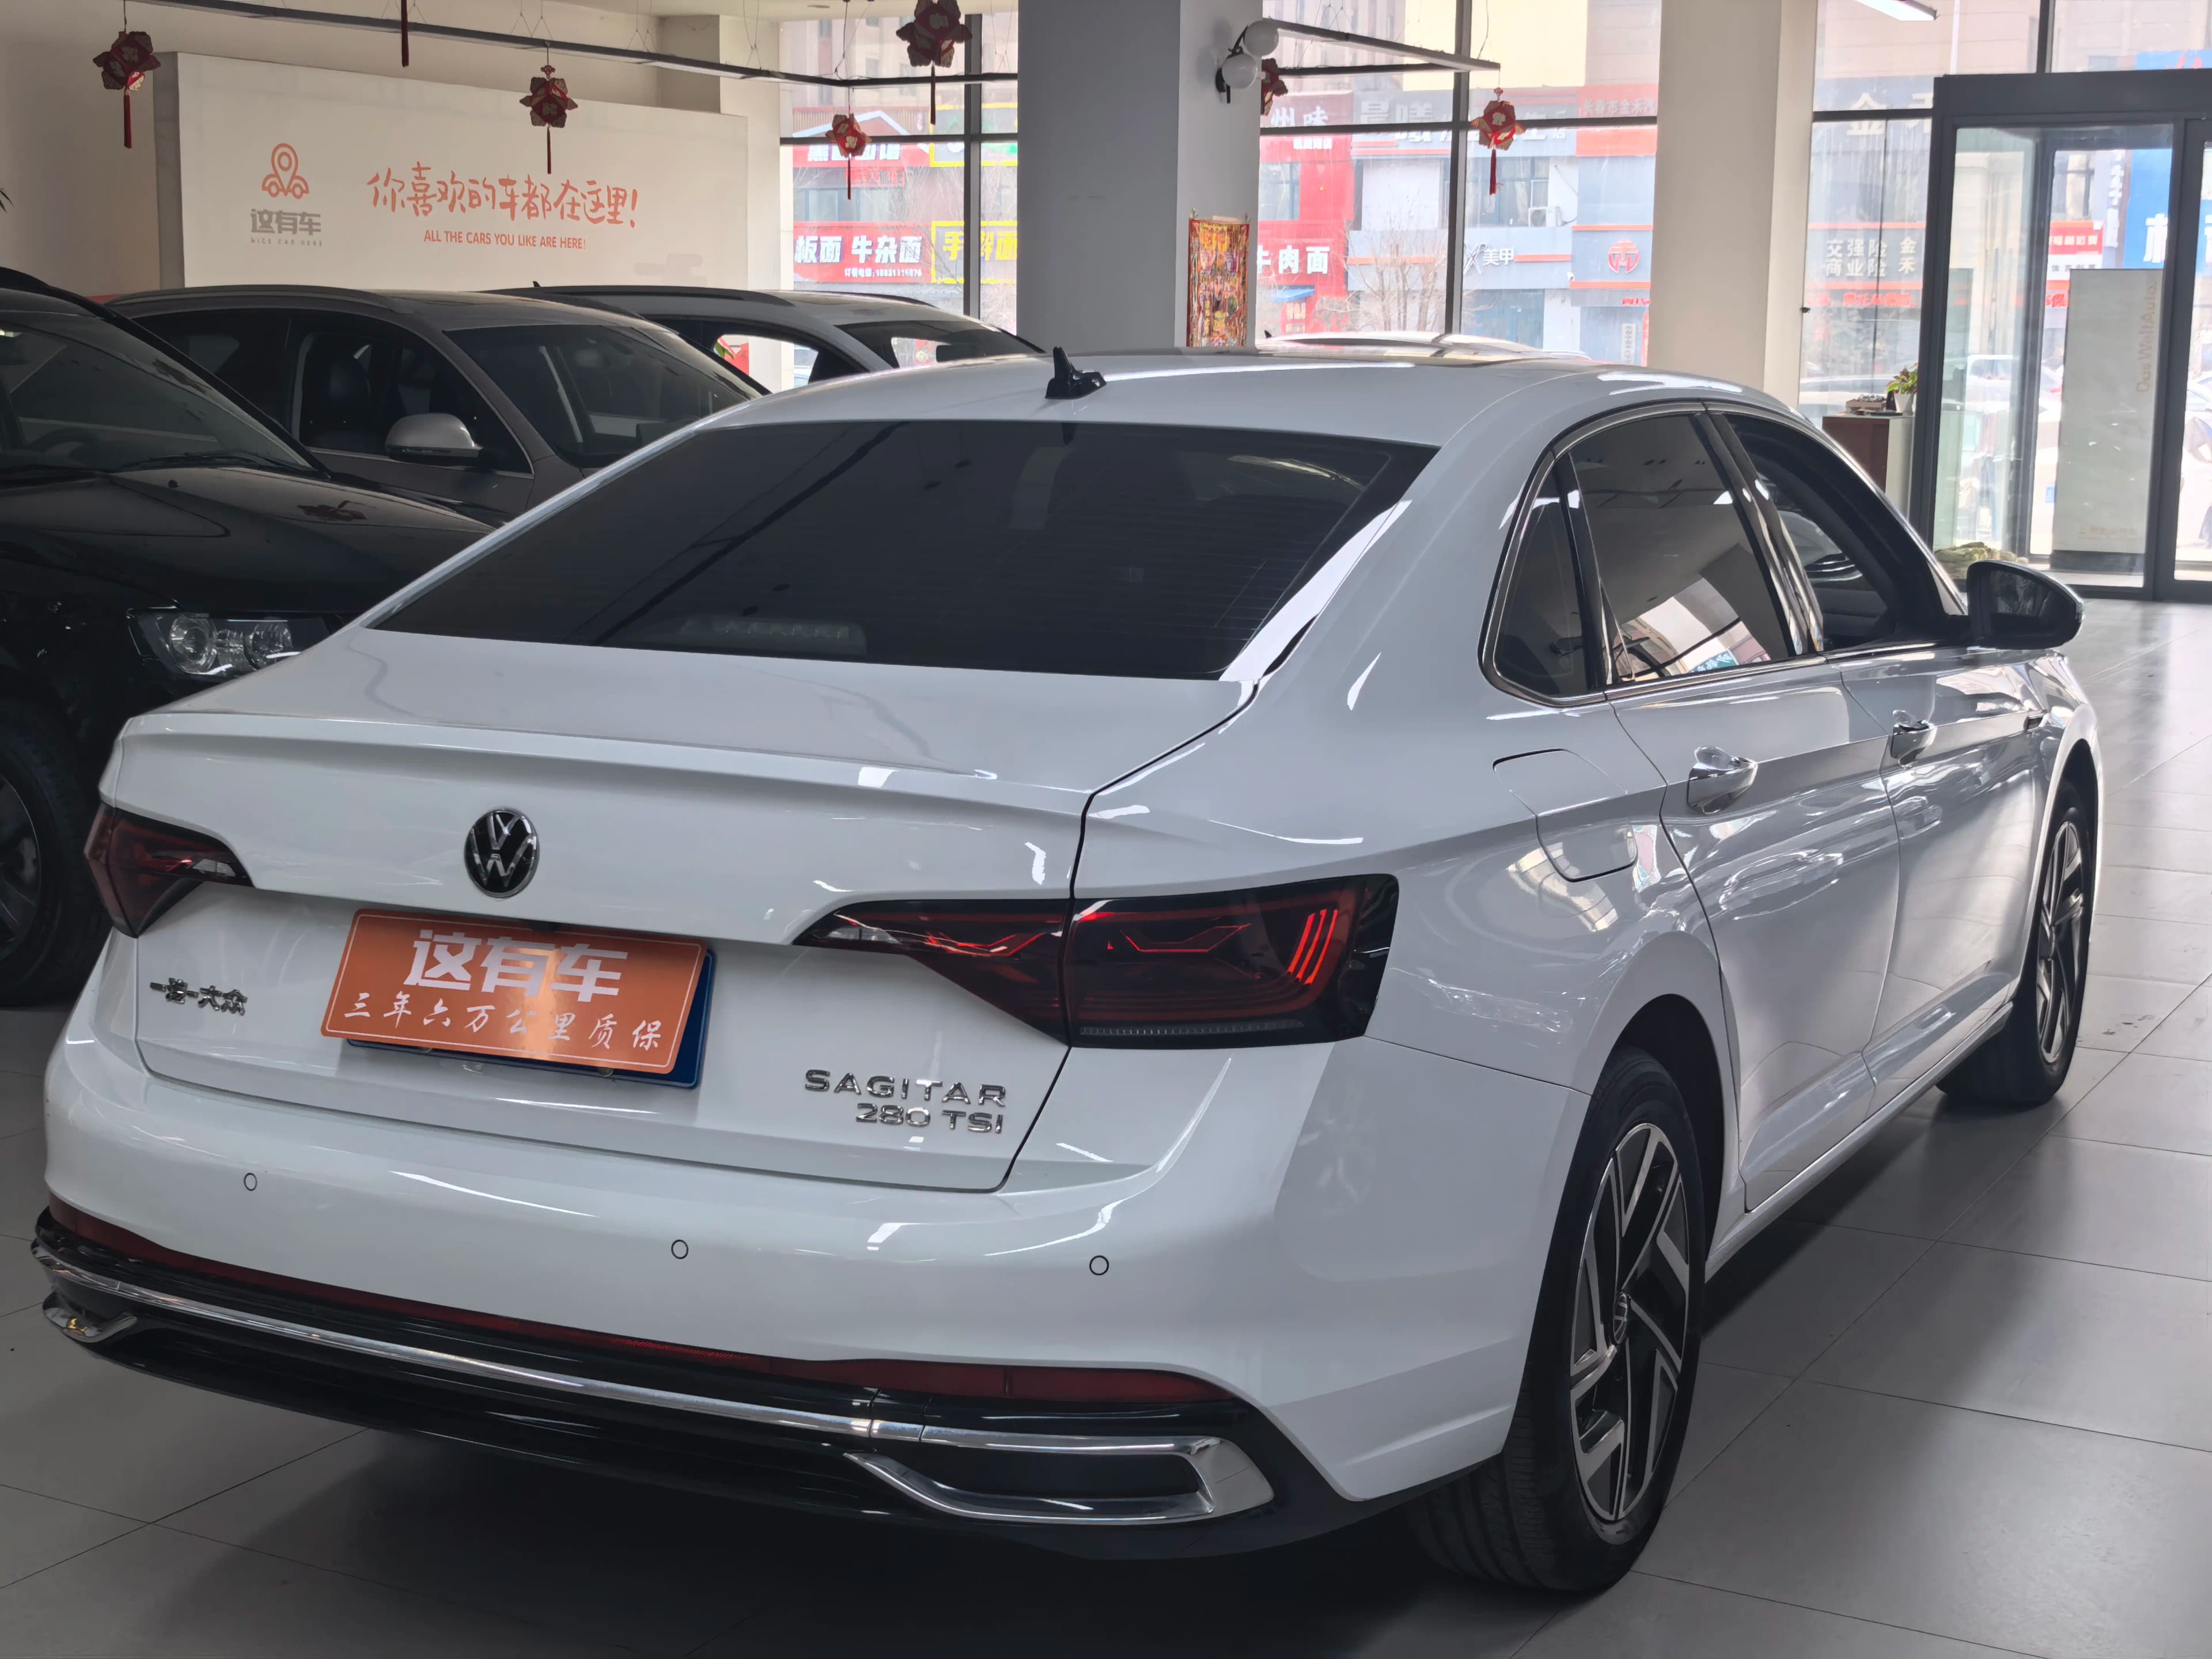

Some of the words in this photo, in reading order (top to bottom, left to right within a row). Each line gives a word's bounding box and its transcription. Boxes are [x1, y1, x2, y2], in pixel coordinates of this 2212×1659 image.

[251, 209, 321, 236] 这有车
[424, 230, 441, 243] ALL
[445, 231, 463, 243] THE
[466, 232, 491, 244] CARS
[494, 233, 514, 245] YOU
[518, 234, 537, 247] LIKE
[540, 236, 557, 248] ARE
[560, 237, 586, 249] HERE!
[851, 235, 922, 263] 牛杂面
[1825, 238, 1888, 258] 交强险
[1257, 244, 1330, 275] 牛肉面
[1483, 248, 1514, 266] 美甲
[1825, 258, 1887, 277] 商业险
[403, 929, 628, 1002] 这有车
[805, 1069, 1006, 1107] SAGITAR
[856, 1103, 931, 1127] 280
[942, 1109, 1003, 1134] TSI
